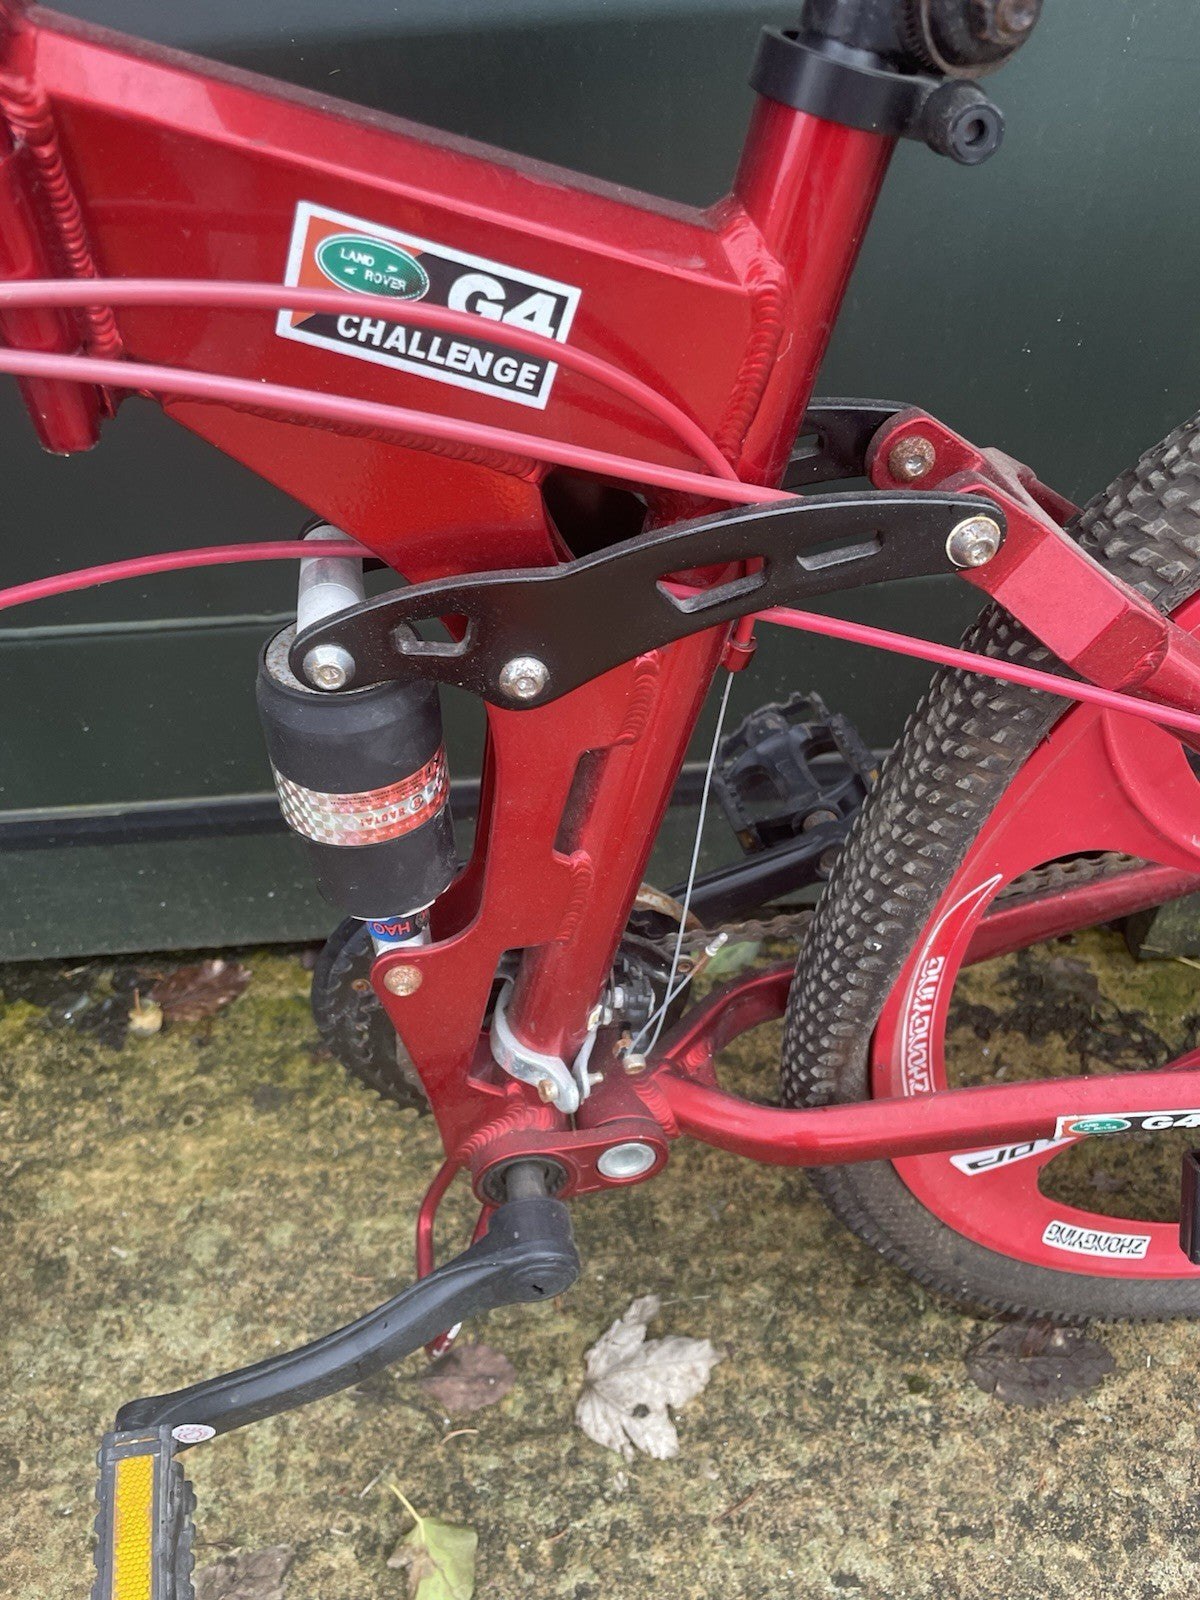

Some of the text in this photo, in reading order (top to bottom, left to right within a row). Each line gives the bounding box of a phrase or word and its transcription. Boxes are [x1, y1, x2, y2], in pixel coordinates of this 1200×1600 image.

[340, 247, 374, 268] LAND
[364, 269, 406, 292] ROVER
[448, 273, 557, 337] G4
[336, 314, 540, 390] CHALLENGE
